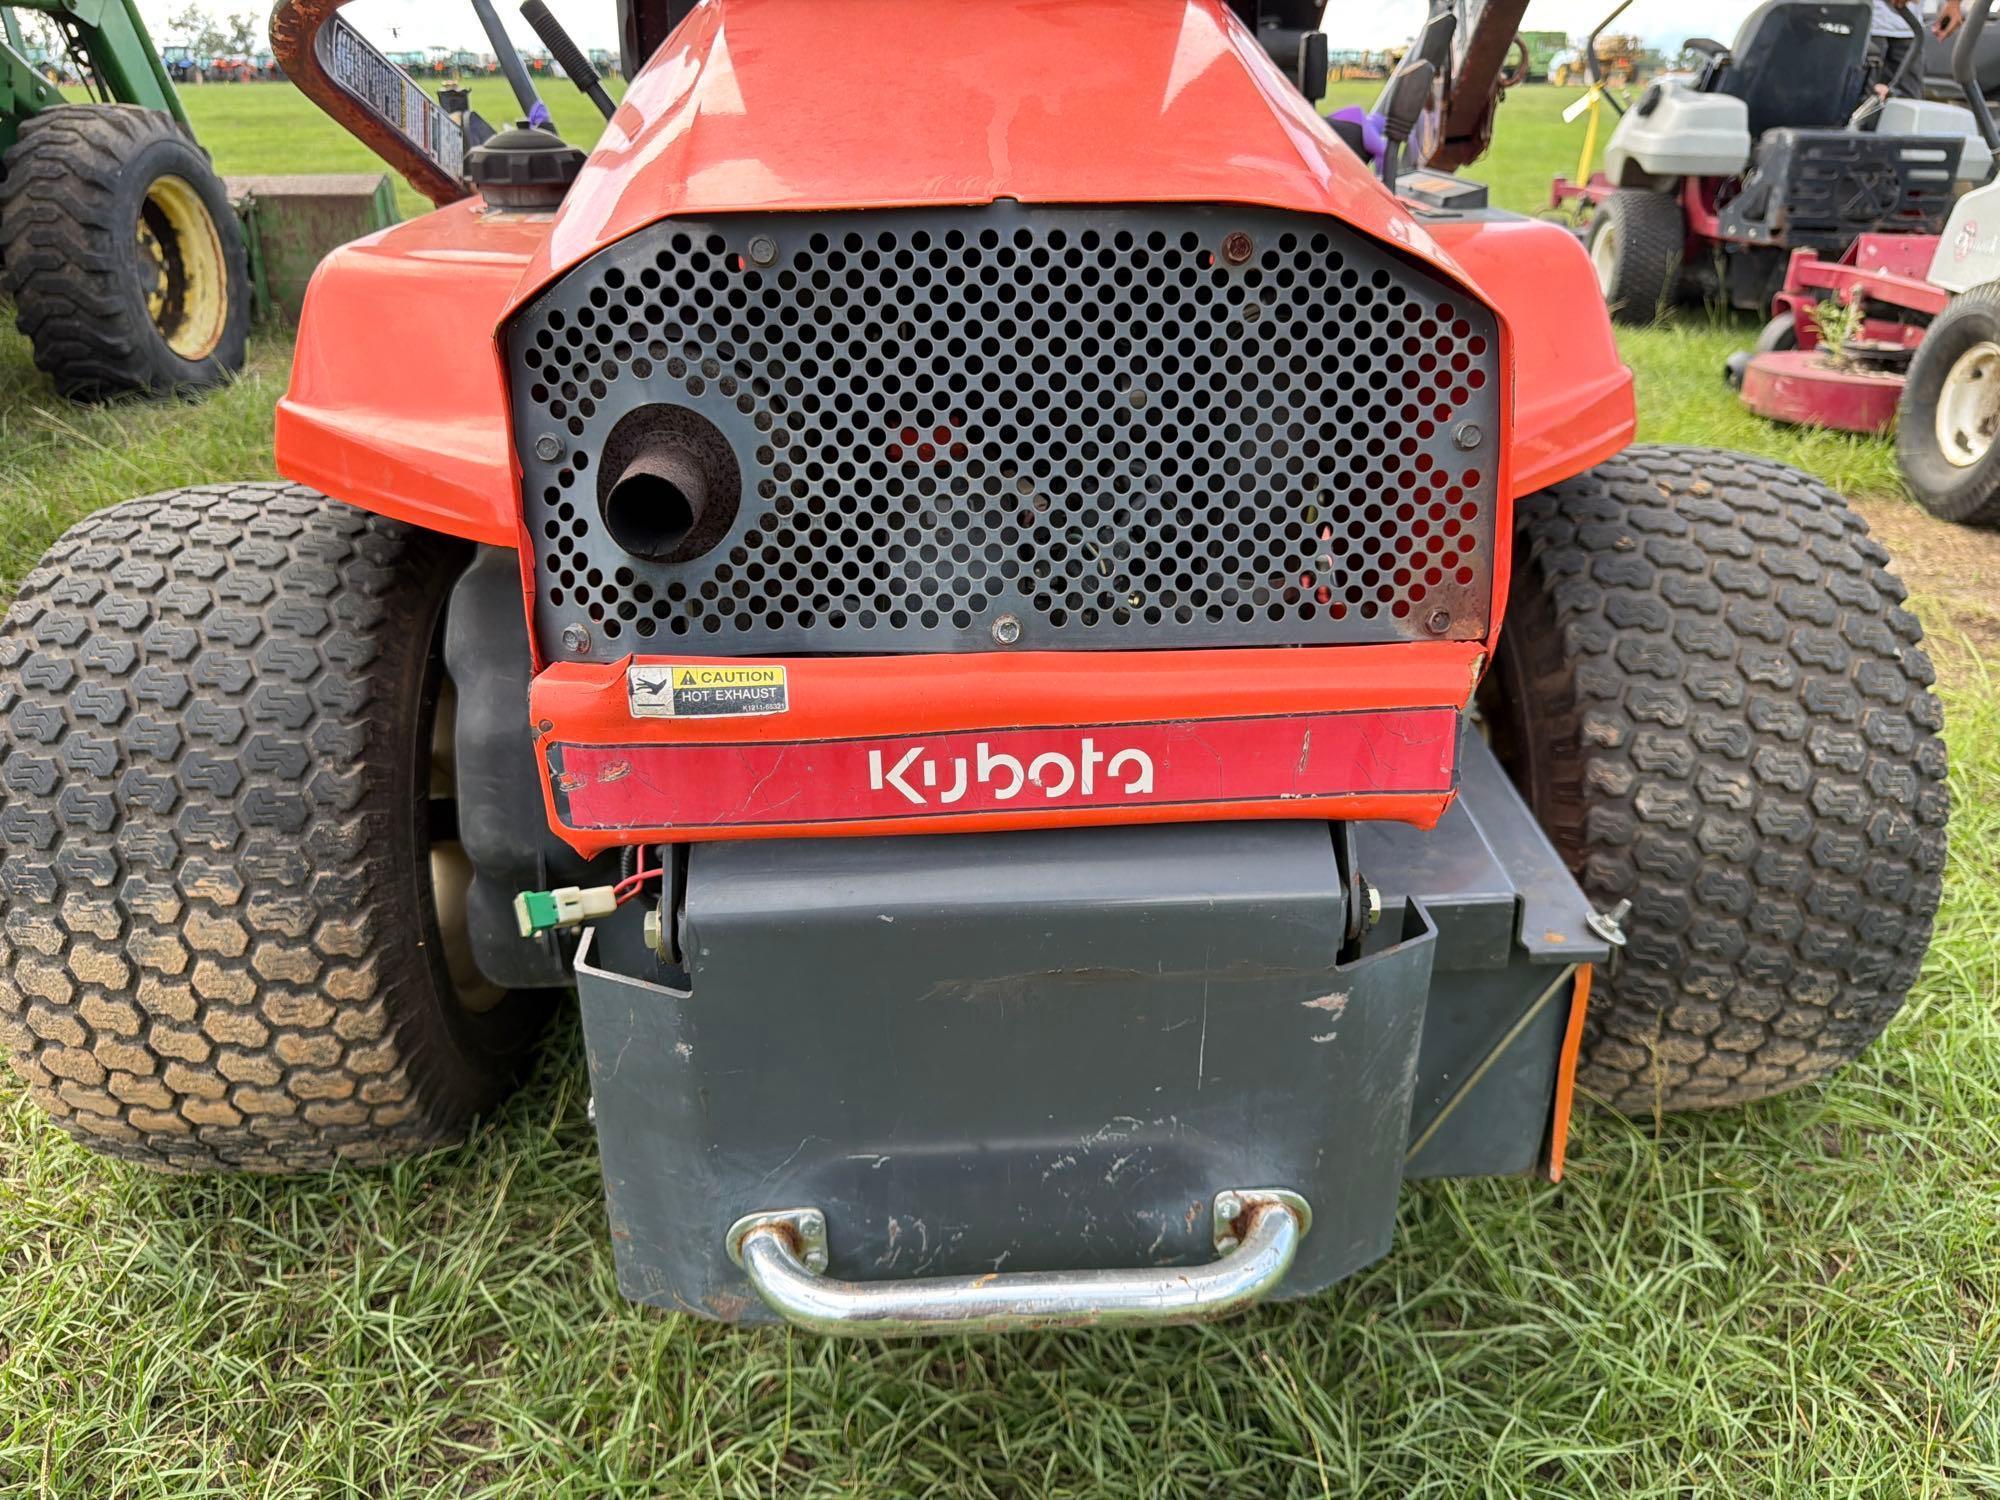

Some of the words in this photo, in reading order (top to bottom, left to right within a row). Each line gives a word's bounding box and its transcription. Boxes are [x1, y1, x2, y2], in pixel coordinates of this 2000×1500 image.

[701, 671, 774, 684] CAUTION
[682, 691, 709, 702] HOT
[715, 688, 777, 701] EXHAUST
[868, 738, 1154, 804] Kubota
